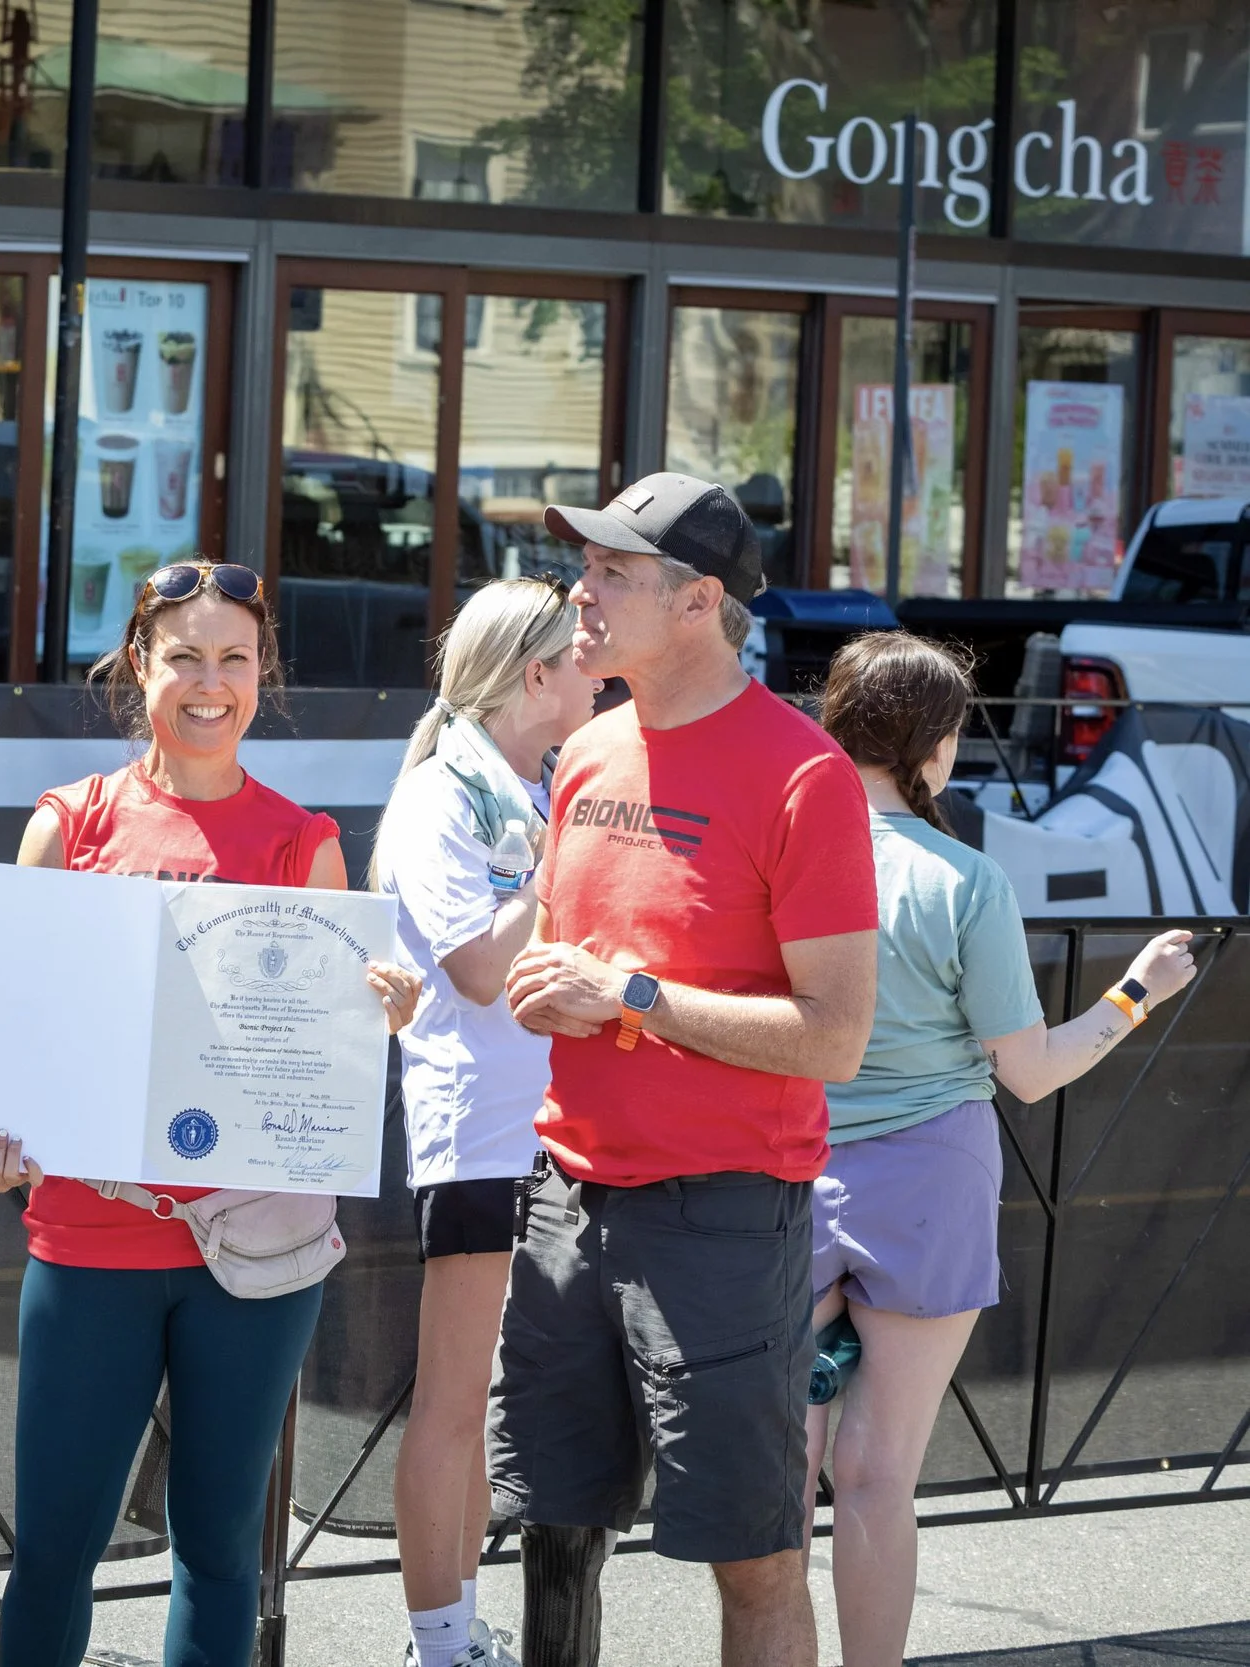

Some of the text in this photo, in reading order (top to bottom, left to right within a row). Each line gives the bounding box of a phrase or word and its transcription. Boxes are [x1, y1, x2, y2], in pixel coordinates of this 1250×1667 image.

[761, 77, 1154, 228] Gong cha
[168, 293, 186, 309] 10
[571, 798, 711, 845] BIONIC
[607, 834, 667, 850] PROJECT
[175, 901, 370, 965] The Commonwealth of Massachusetts
[235, 929, 245, 937] The
[246, 929, 264, 937] House
[272, 931, 314, 940] Representatives
[221, 1002, 261, 1011] Massachusetts
[262, 1004, 279, 1012] House
[287, 1006, 329, 1015] Representatives
[238, 1023, 259, 1031] Bionic
[260, 1024, 282, 1033] Project
[230, 1045, 252, 1053] Cambridge
